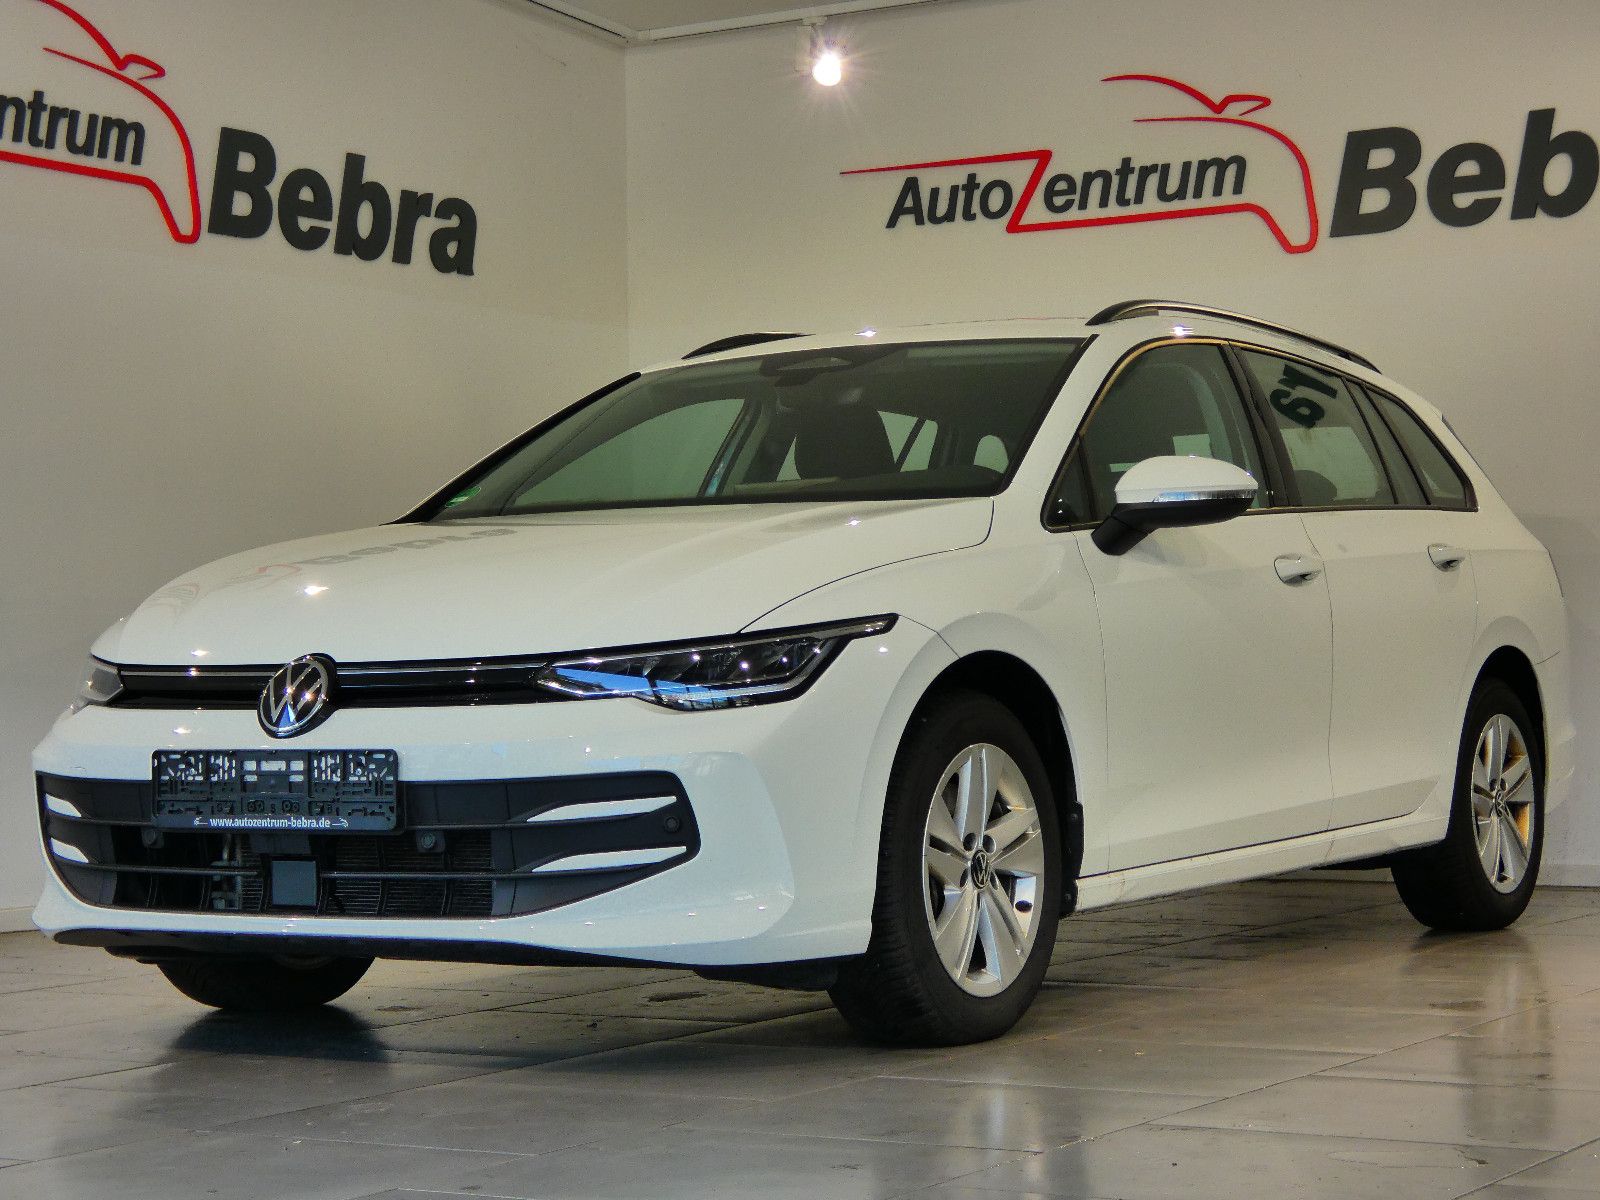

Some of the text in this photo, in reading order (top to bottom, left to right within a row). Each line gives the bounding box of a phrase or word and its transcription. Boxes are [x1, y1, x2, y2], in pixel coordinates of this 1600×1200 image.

[207, 126, 478, 276] Bebra
[1329, 107, 1600, 238] Beb
[209, 816, 331, 828] www.autozentrum-bebra.de
